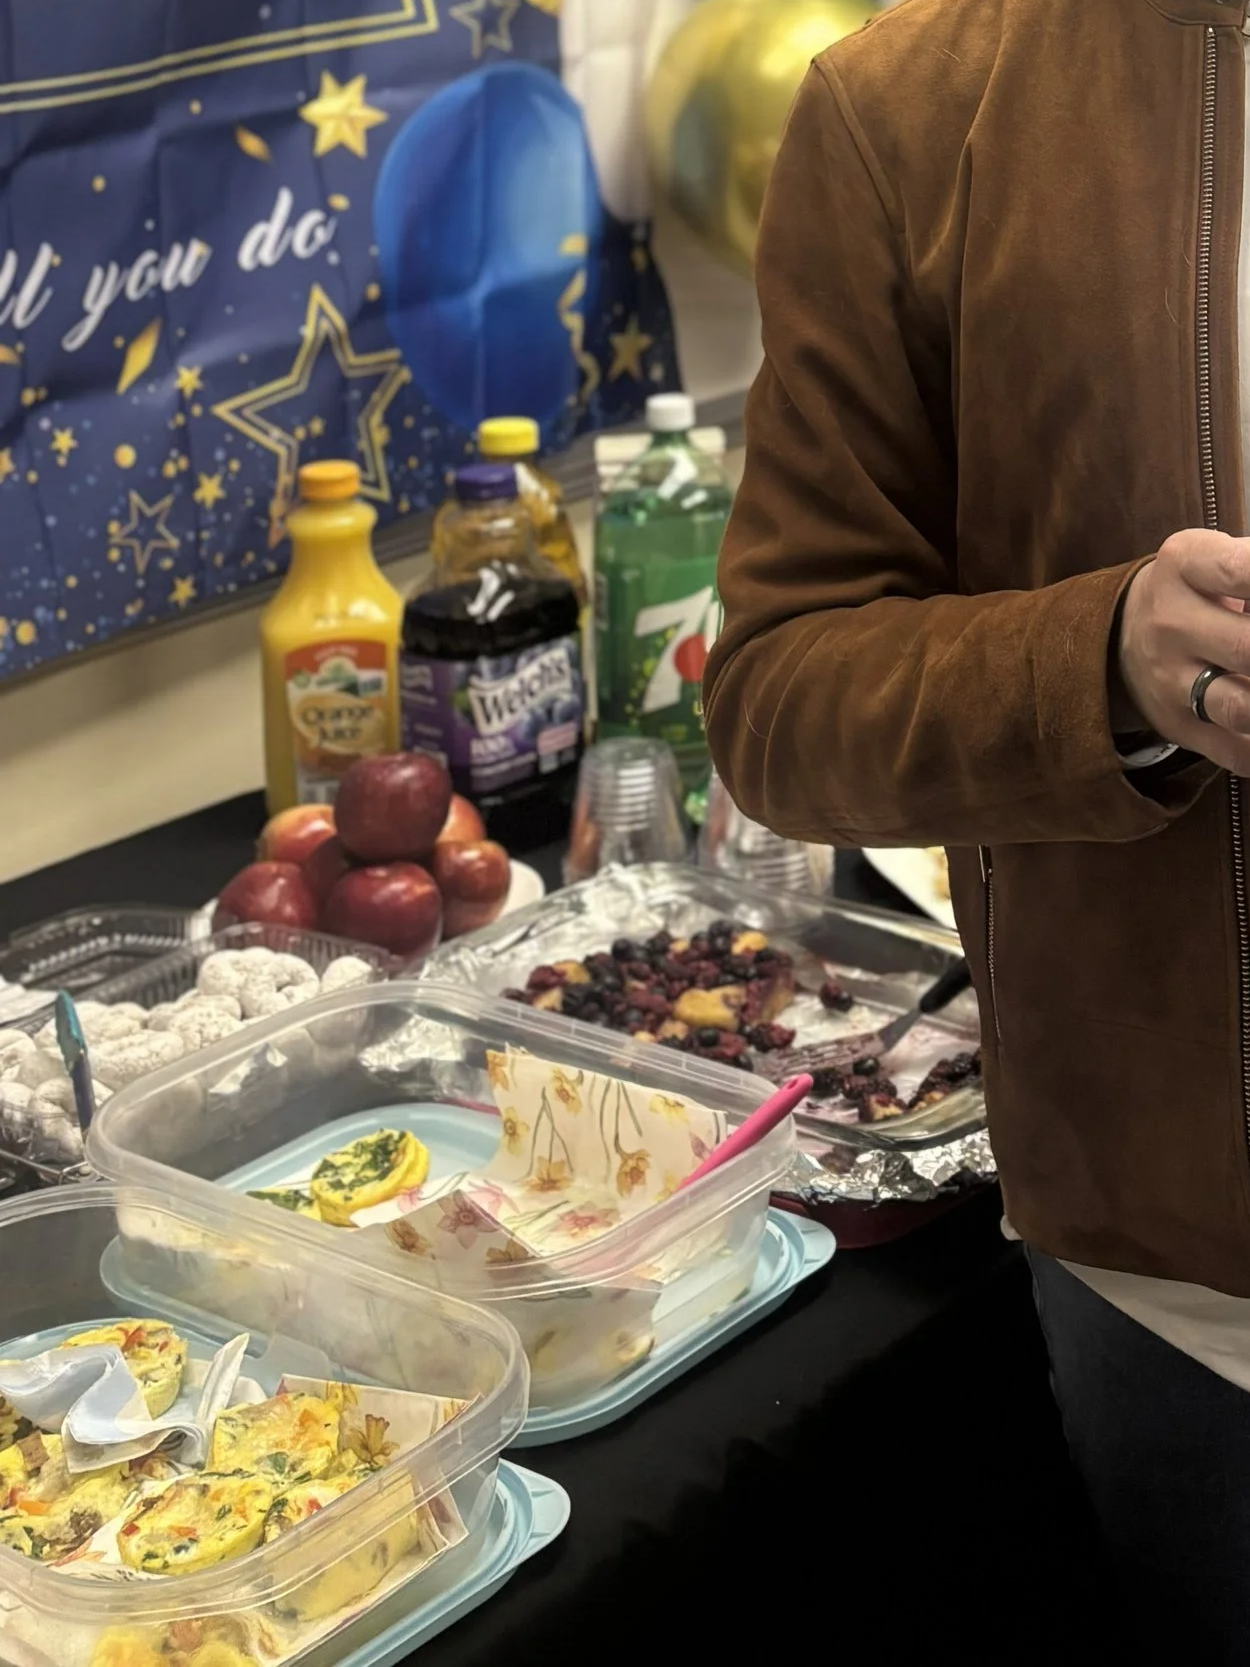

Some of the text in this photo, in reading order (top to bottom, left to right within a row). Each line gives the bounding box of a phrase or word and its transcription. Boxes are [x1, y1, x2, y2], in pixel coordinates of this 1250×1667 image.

[61, 238, 212, 352] you
[477, 653, 566, 725] Welch's
[302, 705, 374, 728] Orange
[318, 725, 362, 741] Juice
